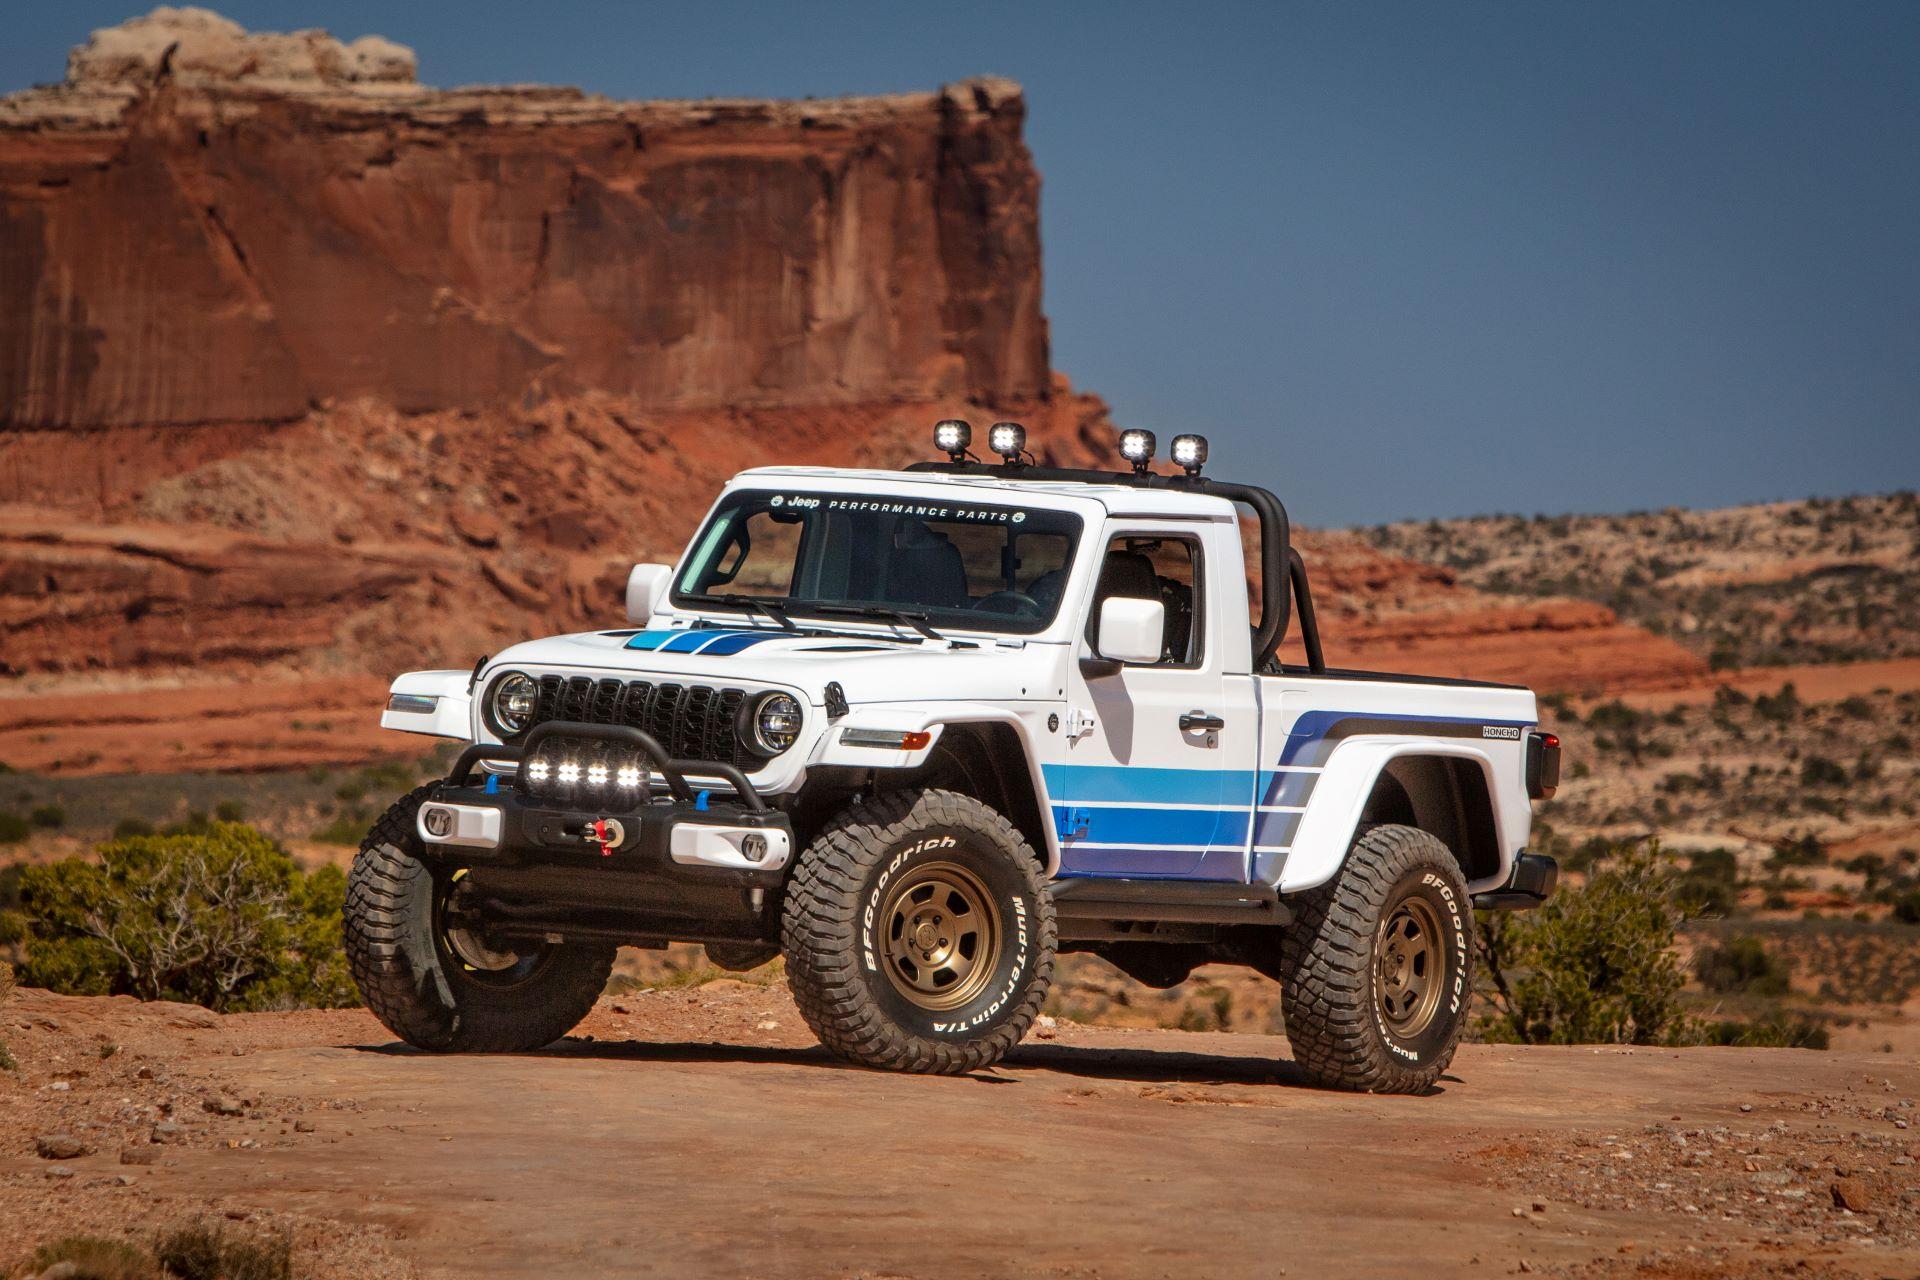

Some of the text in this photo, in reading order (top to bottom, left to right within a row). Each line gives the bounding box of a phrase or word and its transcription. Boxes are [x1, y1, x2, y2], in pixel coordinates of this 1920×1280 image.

[787, 495, 1008, 522] Jeep PERFORMANCE PARTS
[1483, 727, 1519, 738] HONCHO
[863, 836, 957, 972] BFGoodrich
[933, 896, 1028, 1033] Mud-Terrain T/A
[1421, 873, 1467, 1014] BFGoodrich
